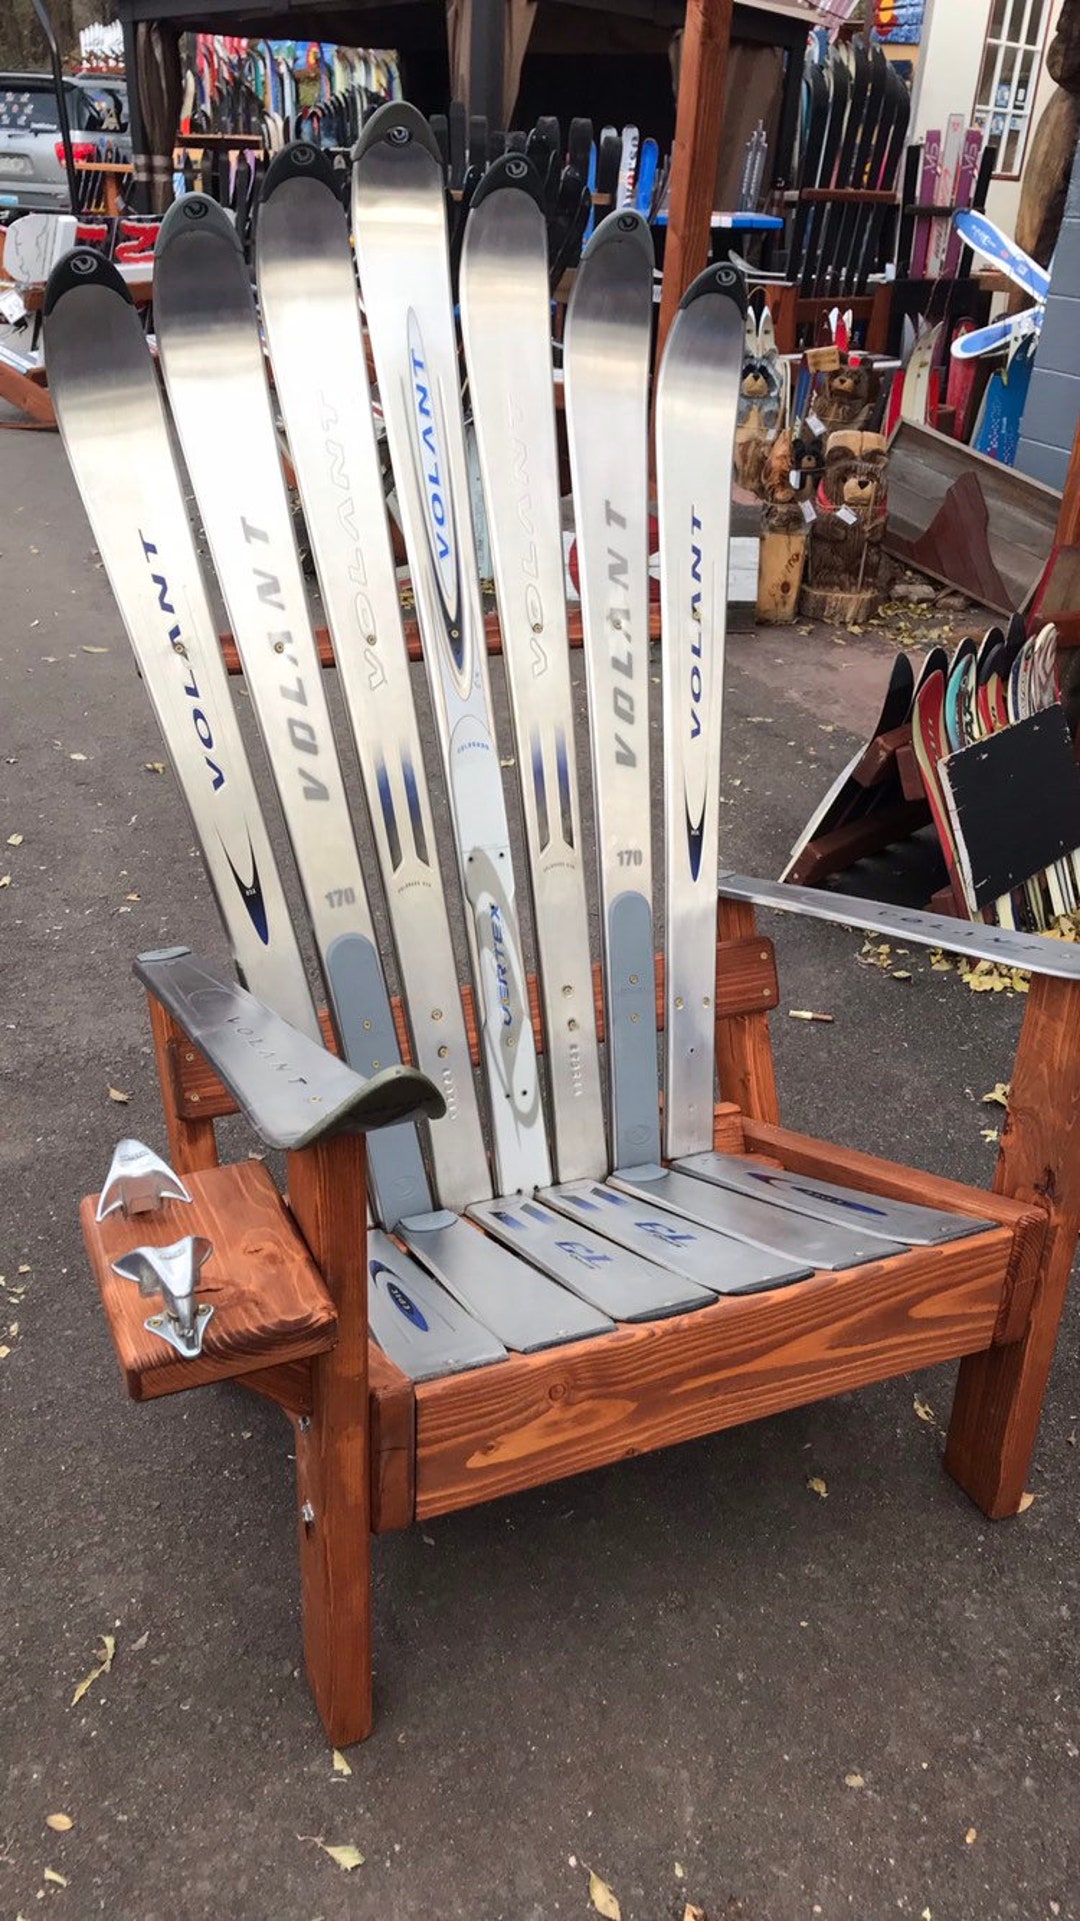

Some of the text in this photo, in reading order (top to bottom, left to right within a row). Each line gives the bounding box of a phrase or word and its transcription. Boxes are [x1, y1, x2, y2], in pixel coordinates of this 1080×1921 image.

[316, 388, 388, 692] VOLANT
[411, 348, 449, 560] VOLANT
[138, 528, 225, 792] VOLANT
[240, 515, 330, 802] VOLANT
[603, 500, 638, 769] VOLANT
[690, 503, 703, 740] VOLANT
[325, 886, 357, 909] 170
[616, 849, 643, 868] 170
[226, 1013, 309, 1087] VOLANT
